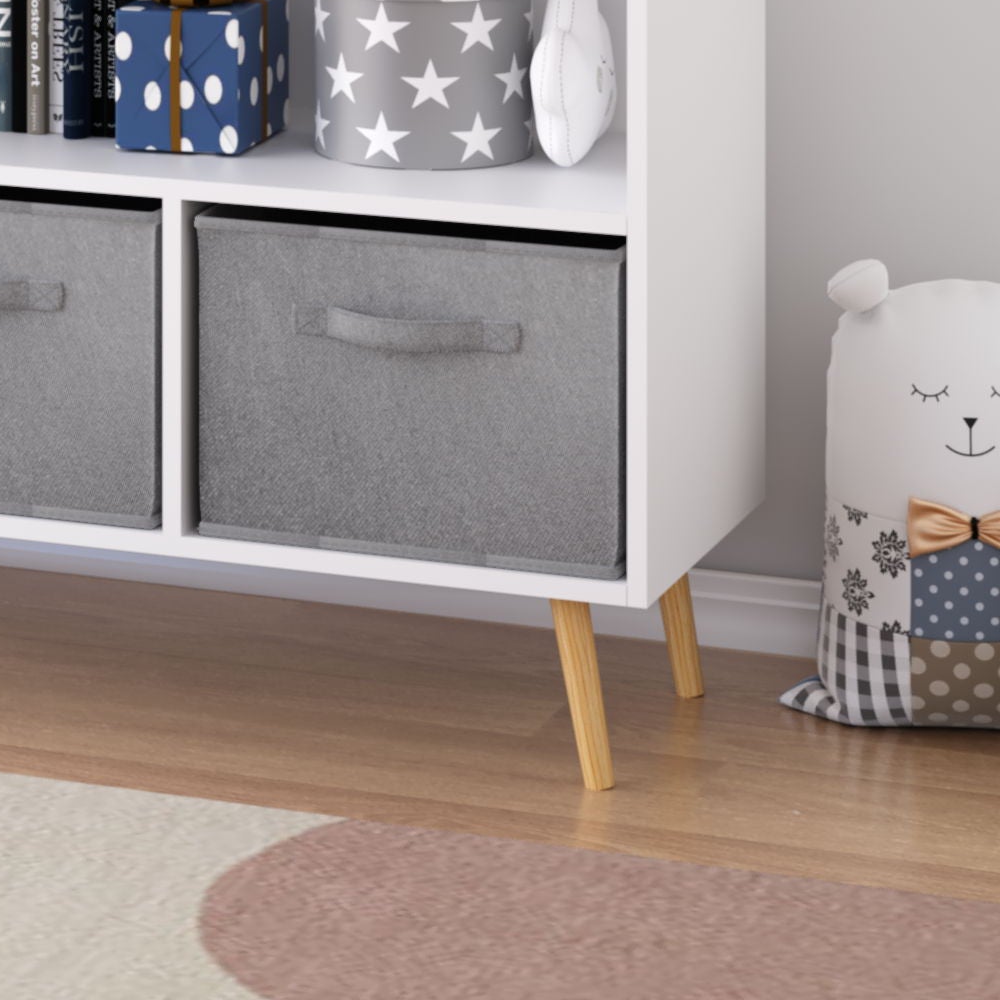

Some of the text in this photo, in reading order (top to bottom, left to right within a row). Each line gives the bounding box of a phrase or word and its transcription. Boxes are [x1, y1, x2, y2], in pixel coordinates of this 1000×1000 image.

[93, 13, 102, 28] &
[107, 14, 116, 28] &
[31, 41, 39, 61] on
[31, 63, 41, 87] Art
[93, 30, 102, 98] ARTISTS
[107, 31, 116, 99] ARTISTS
